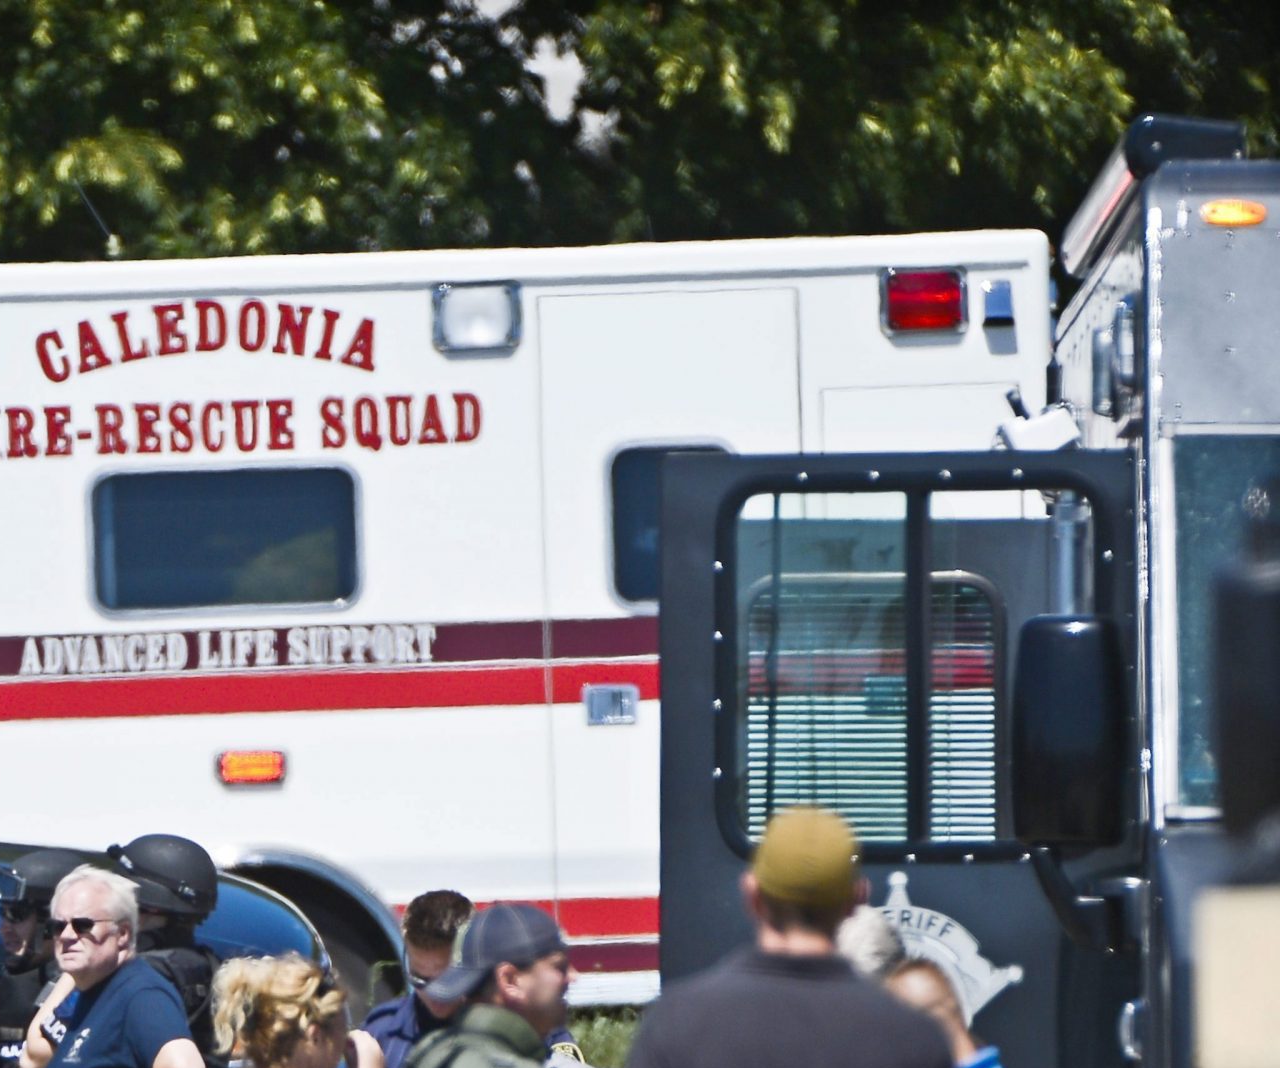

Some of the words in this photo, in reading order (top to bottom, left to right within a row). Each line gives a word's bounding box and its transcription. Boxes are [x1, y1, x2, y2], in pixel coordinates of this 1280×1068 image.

[35, 298, 376, 383] CALEDONIA
[320, 392, 484, 452] SQUAD
[20, 633, 189, 676] ADVANCED
[197, 628, 278, 669] LIFE
[286, 622, 437, 665] SUPPORT
